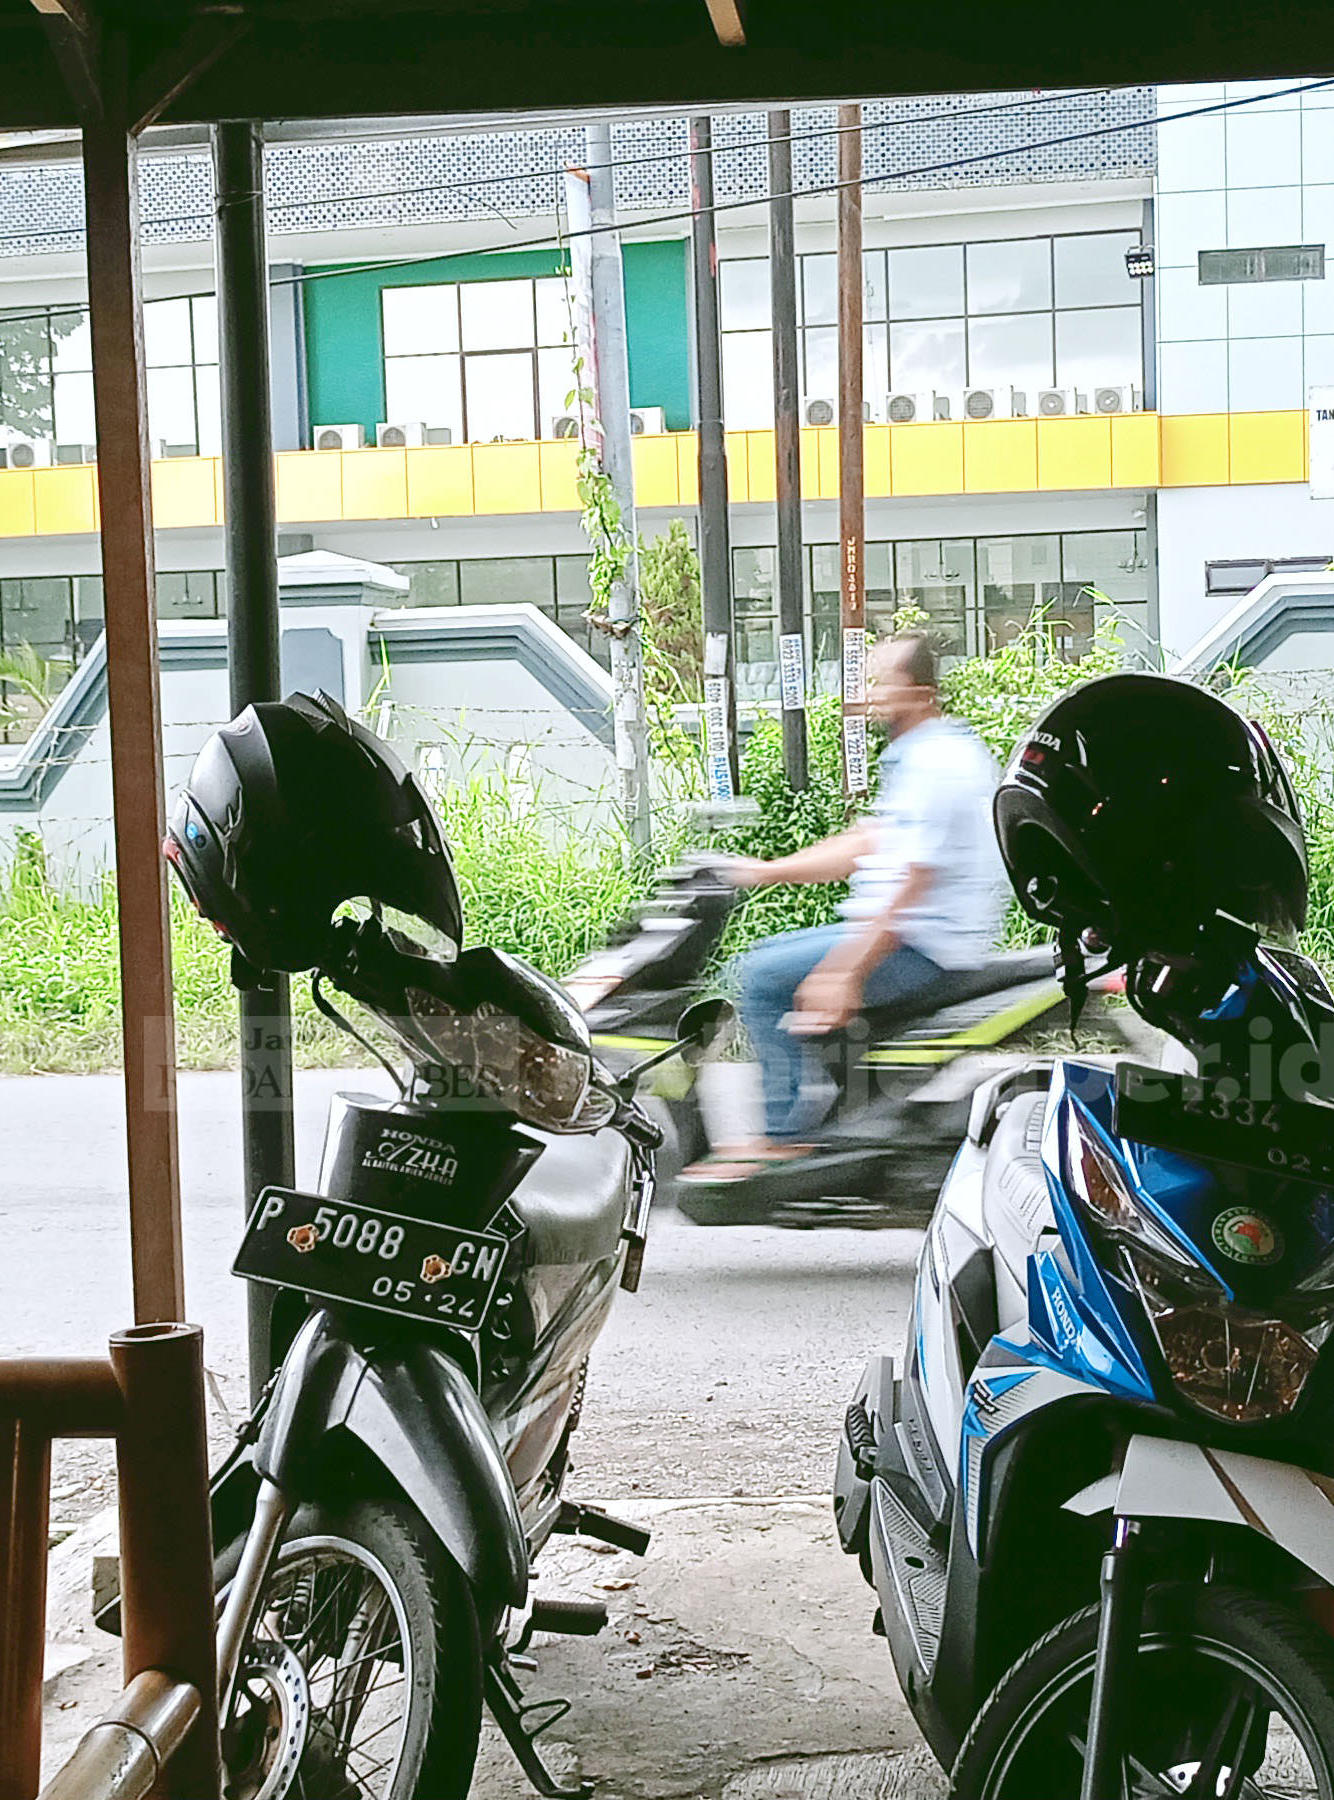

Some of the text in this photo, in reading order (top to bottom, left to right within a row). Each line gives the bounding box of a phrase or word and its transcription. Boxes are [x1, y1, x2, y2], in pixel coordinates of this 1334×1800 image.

[1182, 1085, 1283, 1133] 2334
[380, 1128, 456, 1154] HONDA
[255, 1196, 501, 1283] P 5088 GN
